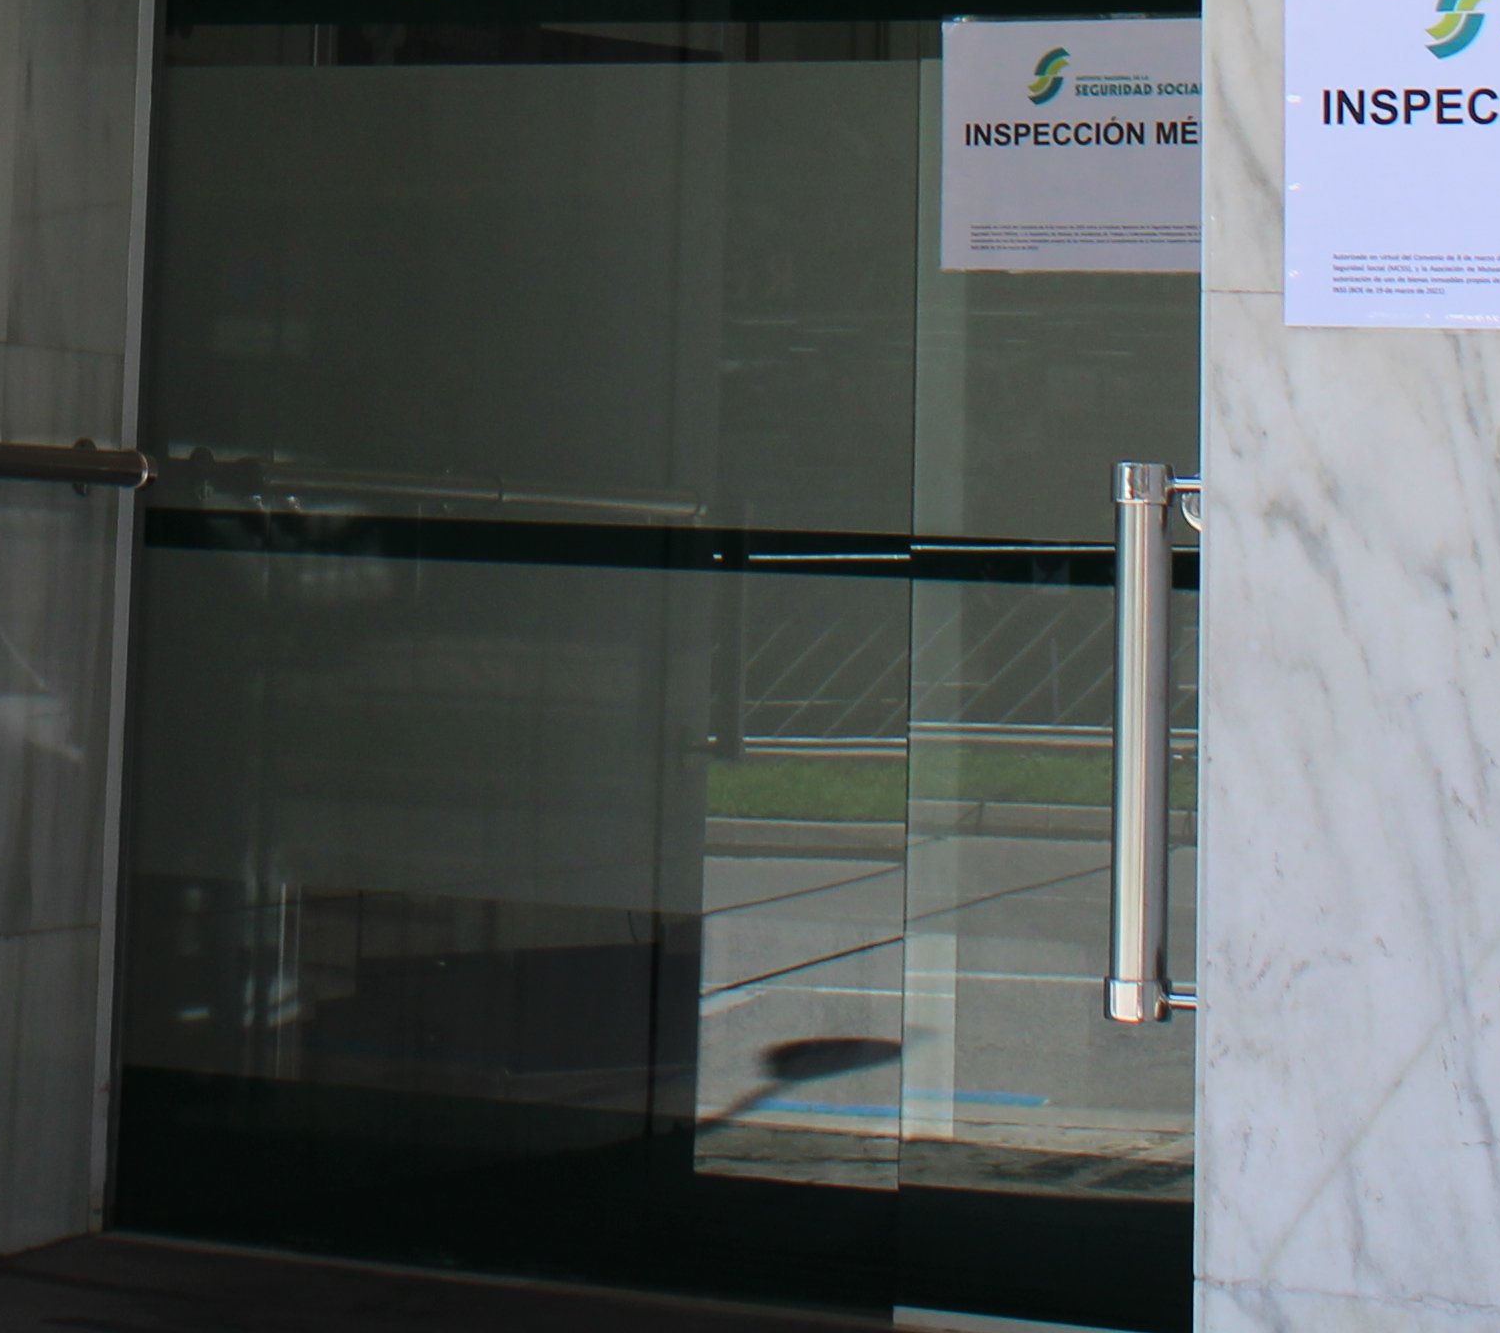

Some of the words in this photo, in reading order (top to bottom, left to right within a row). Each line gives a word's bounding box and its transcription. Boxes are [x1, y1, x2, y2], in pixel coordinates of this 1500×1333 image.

[1075, 83, 1152, 96] SEGURIDAD
[1156, 82, 1201, 95] SOCIA
[965, 116, 1145, 146] INSPECCIÓN
[1156, 115, 1200, 144] MÉ
